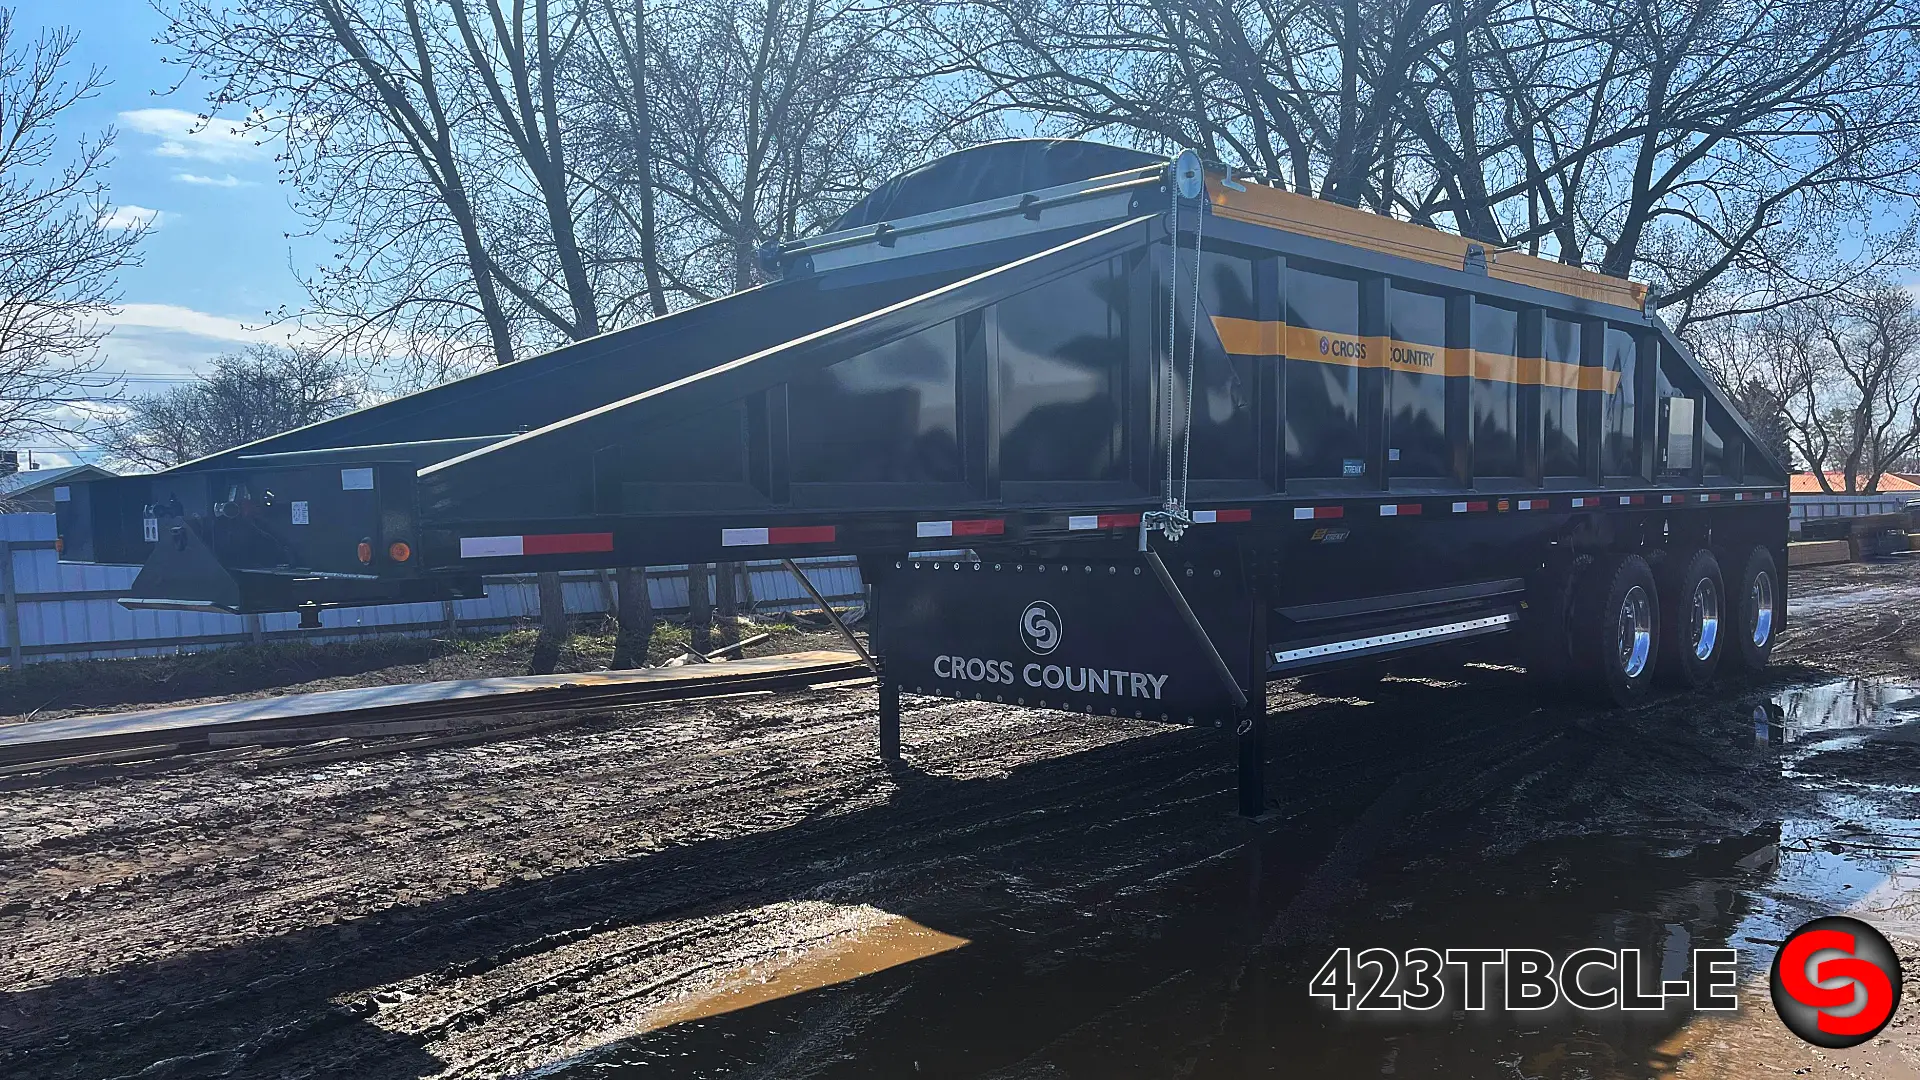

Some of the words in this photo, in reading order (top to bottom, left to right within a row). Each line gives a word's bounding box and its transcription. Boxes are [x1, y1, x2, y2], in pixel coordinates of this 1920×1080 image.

[1331, 340, 1367, 359] CROSS
[933, 654, 1014, 685] CROSS
[1022, 662, 1169, 700] COUNTRY
